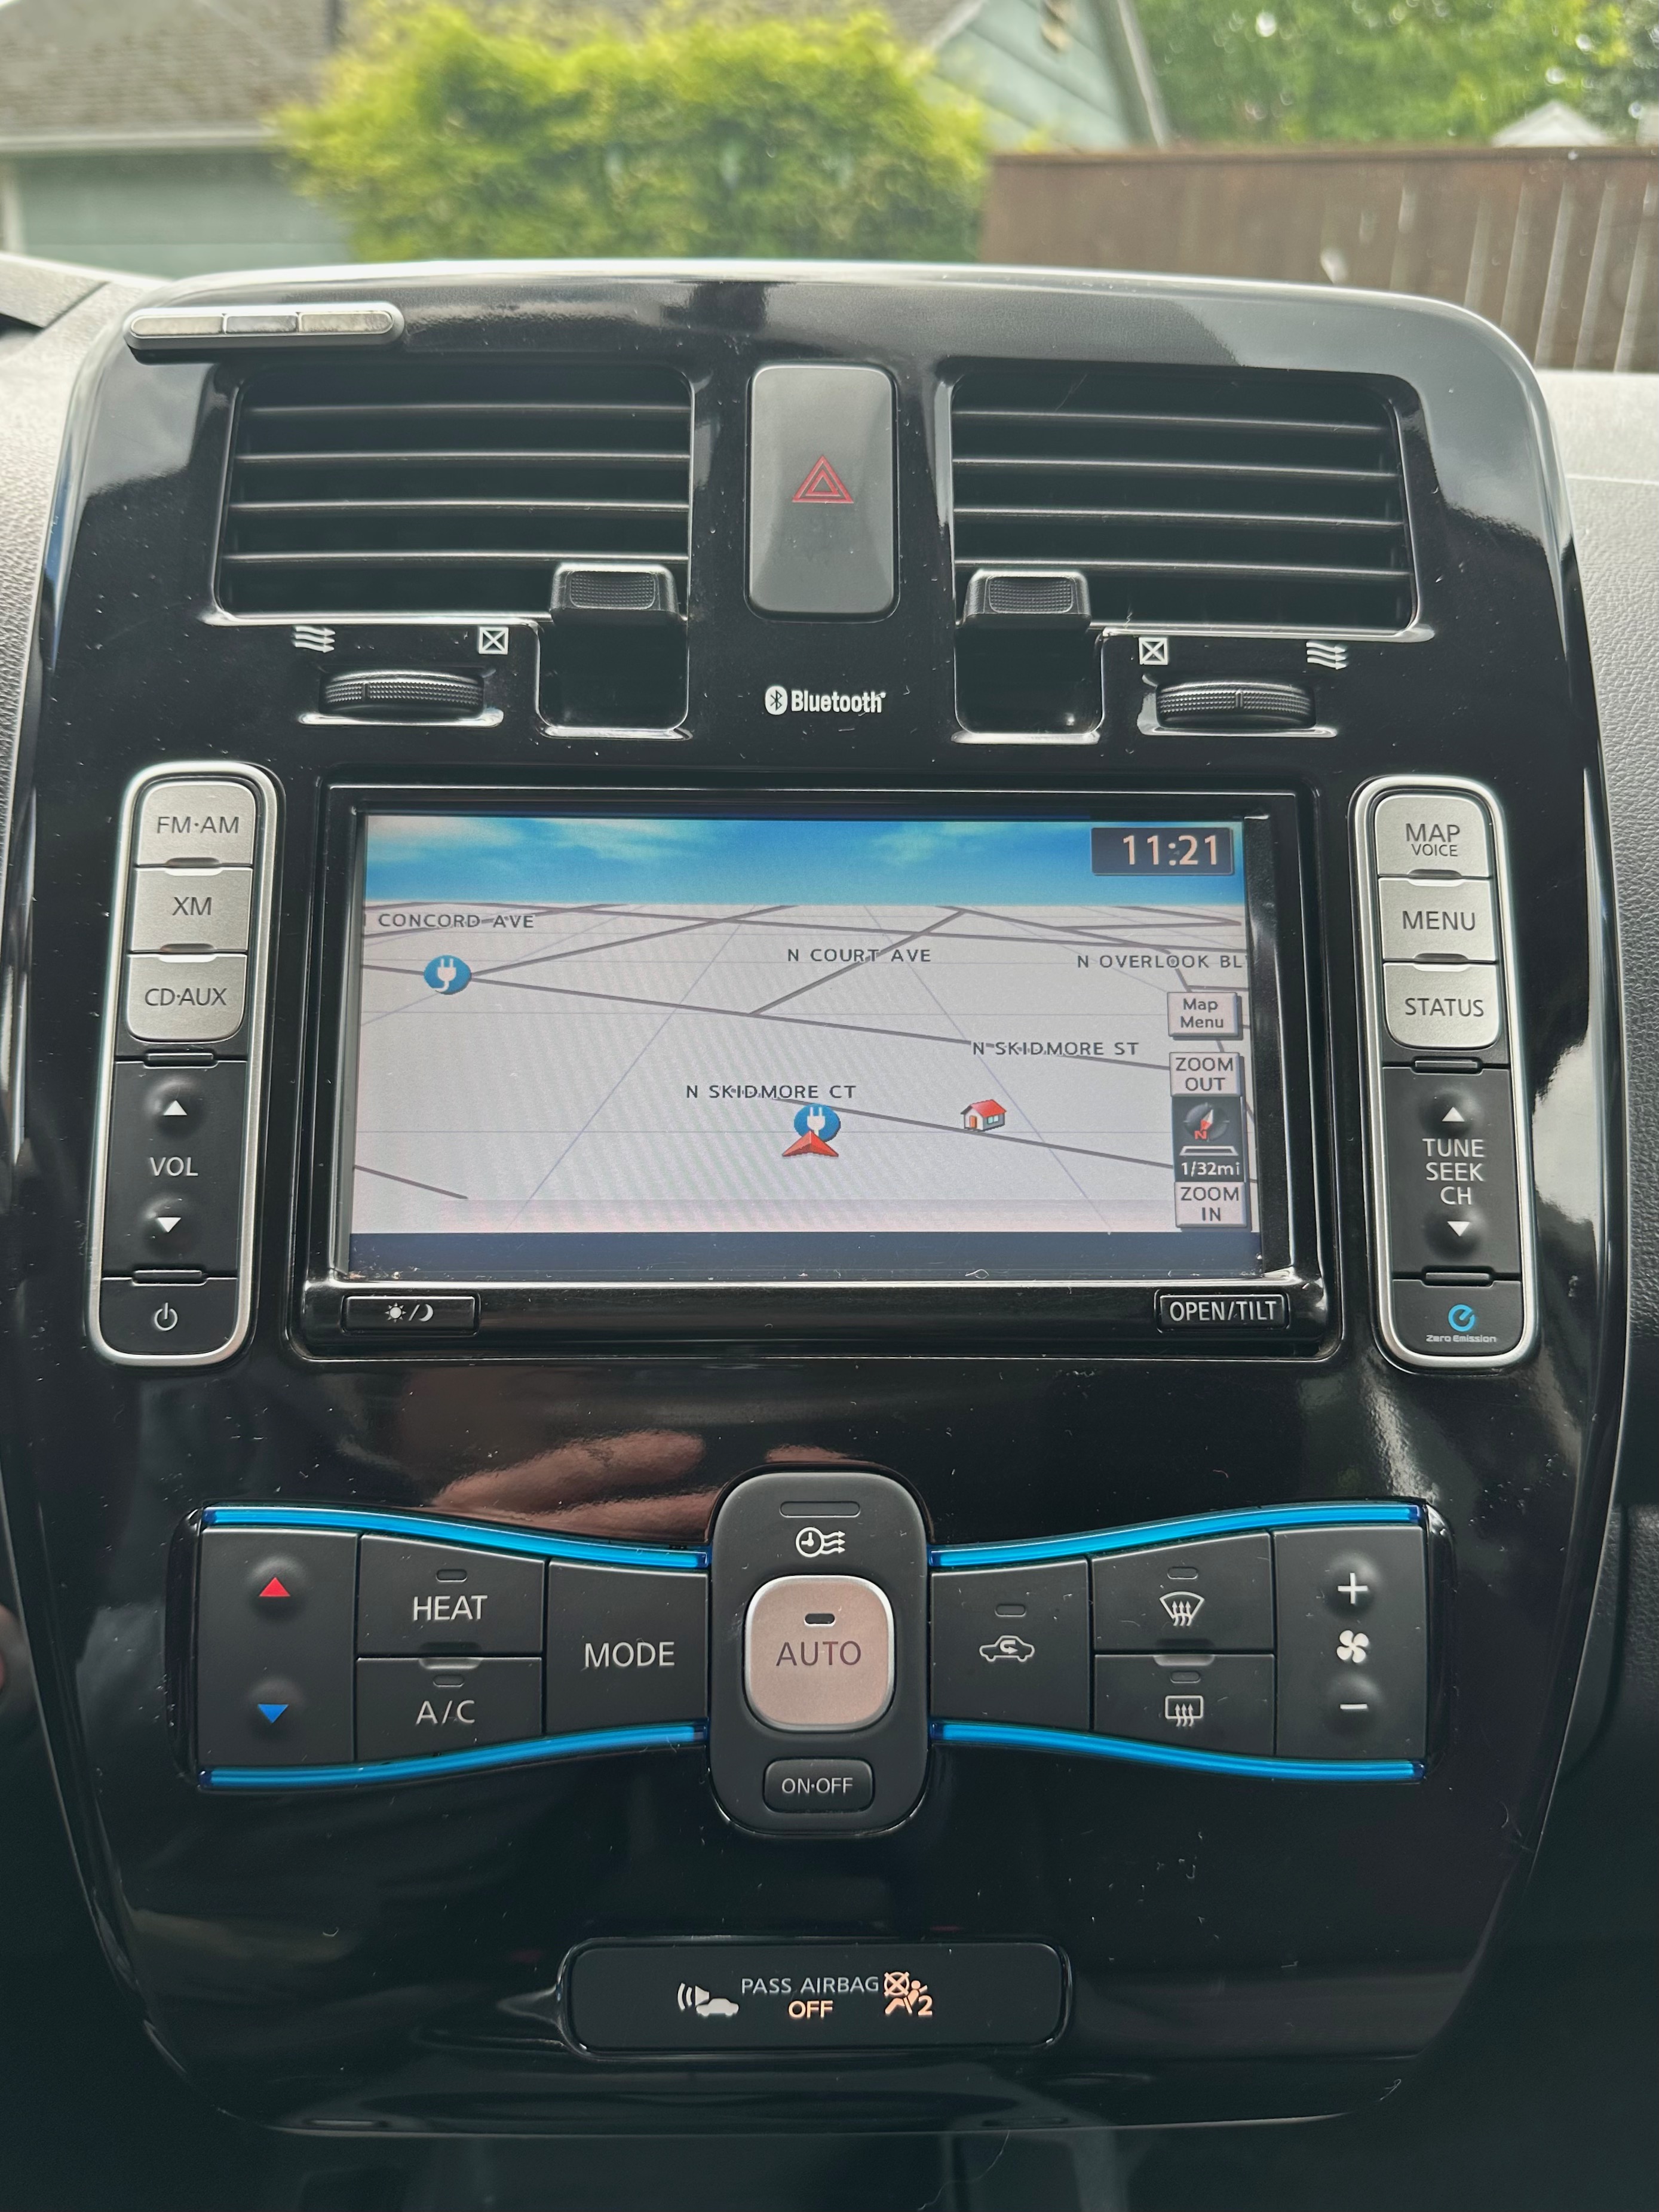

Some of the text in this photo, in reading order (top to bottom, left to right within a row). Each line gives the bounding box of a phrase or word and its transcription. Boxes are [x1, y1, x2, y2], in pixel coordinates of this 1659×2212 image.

[1406, 823, 1460, 842] MAP
[1121, 835, 1220, 866] 11:21
[1411, 843, 1458, 857] VOICE
[172, 897, 213, 916] XM
[378, 913, 480, 928] CONCORD
[493, 915, 534, 928] AVE
[1402, 910, 1476, 931] MENU
[788, 949, 931, 962] N COURT AVE
[1078, 955, 1088, 968] N
[1099, 955, 1209, 968] OVERLOOK
[1183, 998, 1218, 1013] Map
[1405, 998, 1484, 1017] STATUS
[1180, 1016, 1223, 1028] Menu
[973, 1042, 1139, 1056] N SKIDMORE ST
[1176, 1057, 1233, 1071] ZOOM
[686, 1085, 857, 1099] N SKIDMORE CT
[1185, 1078, 1226, 1091] OUT
[1422, 1138, 1485, 1158] TUNE
[149, 1156, 198, 1177] VOL
[1182, 1161, 1240, 1177] 1/32mi
[1425, 1162, 1485, 1182] SEEK
[1180, 1187, 1239, 1201] ZOOM
[1440, 1186, 1473, 1205] CH
[1202, 1207, 1221, 1222] IN
[1169, 1299, 1278, 1323] OPEN/TILT
[1452, 1334, 1497, 1343] Emission
[412, 1594, 489, 1621] HEAT
[584, 1642, 675, 1668] MODE
[776, 1640, 862, 1668] AUTO
[415, 1699, 476, 1725] A/C
[741, 1976, 879, 1994] PASS AIRBAG
[788, 2000, 833, 2018] OFF
